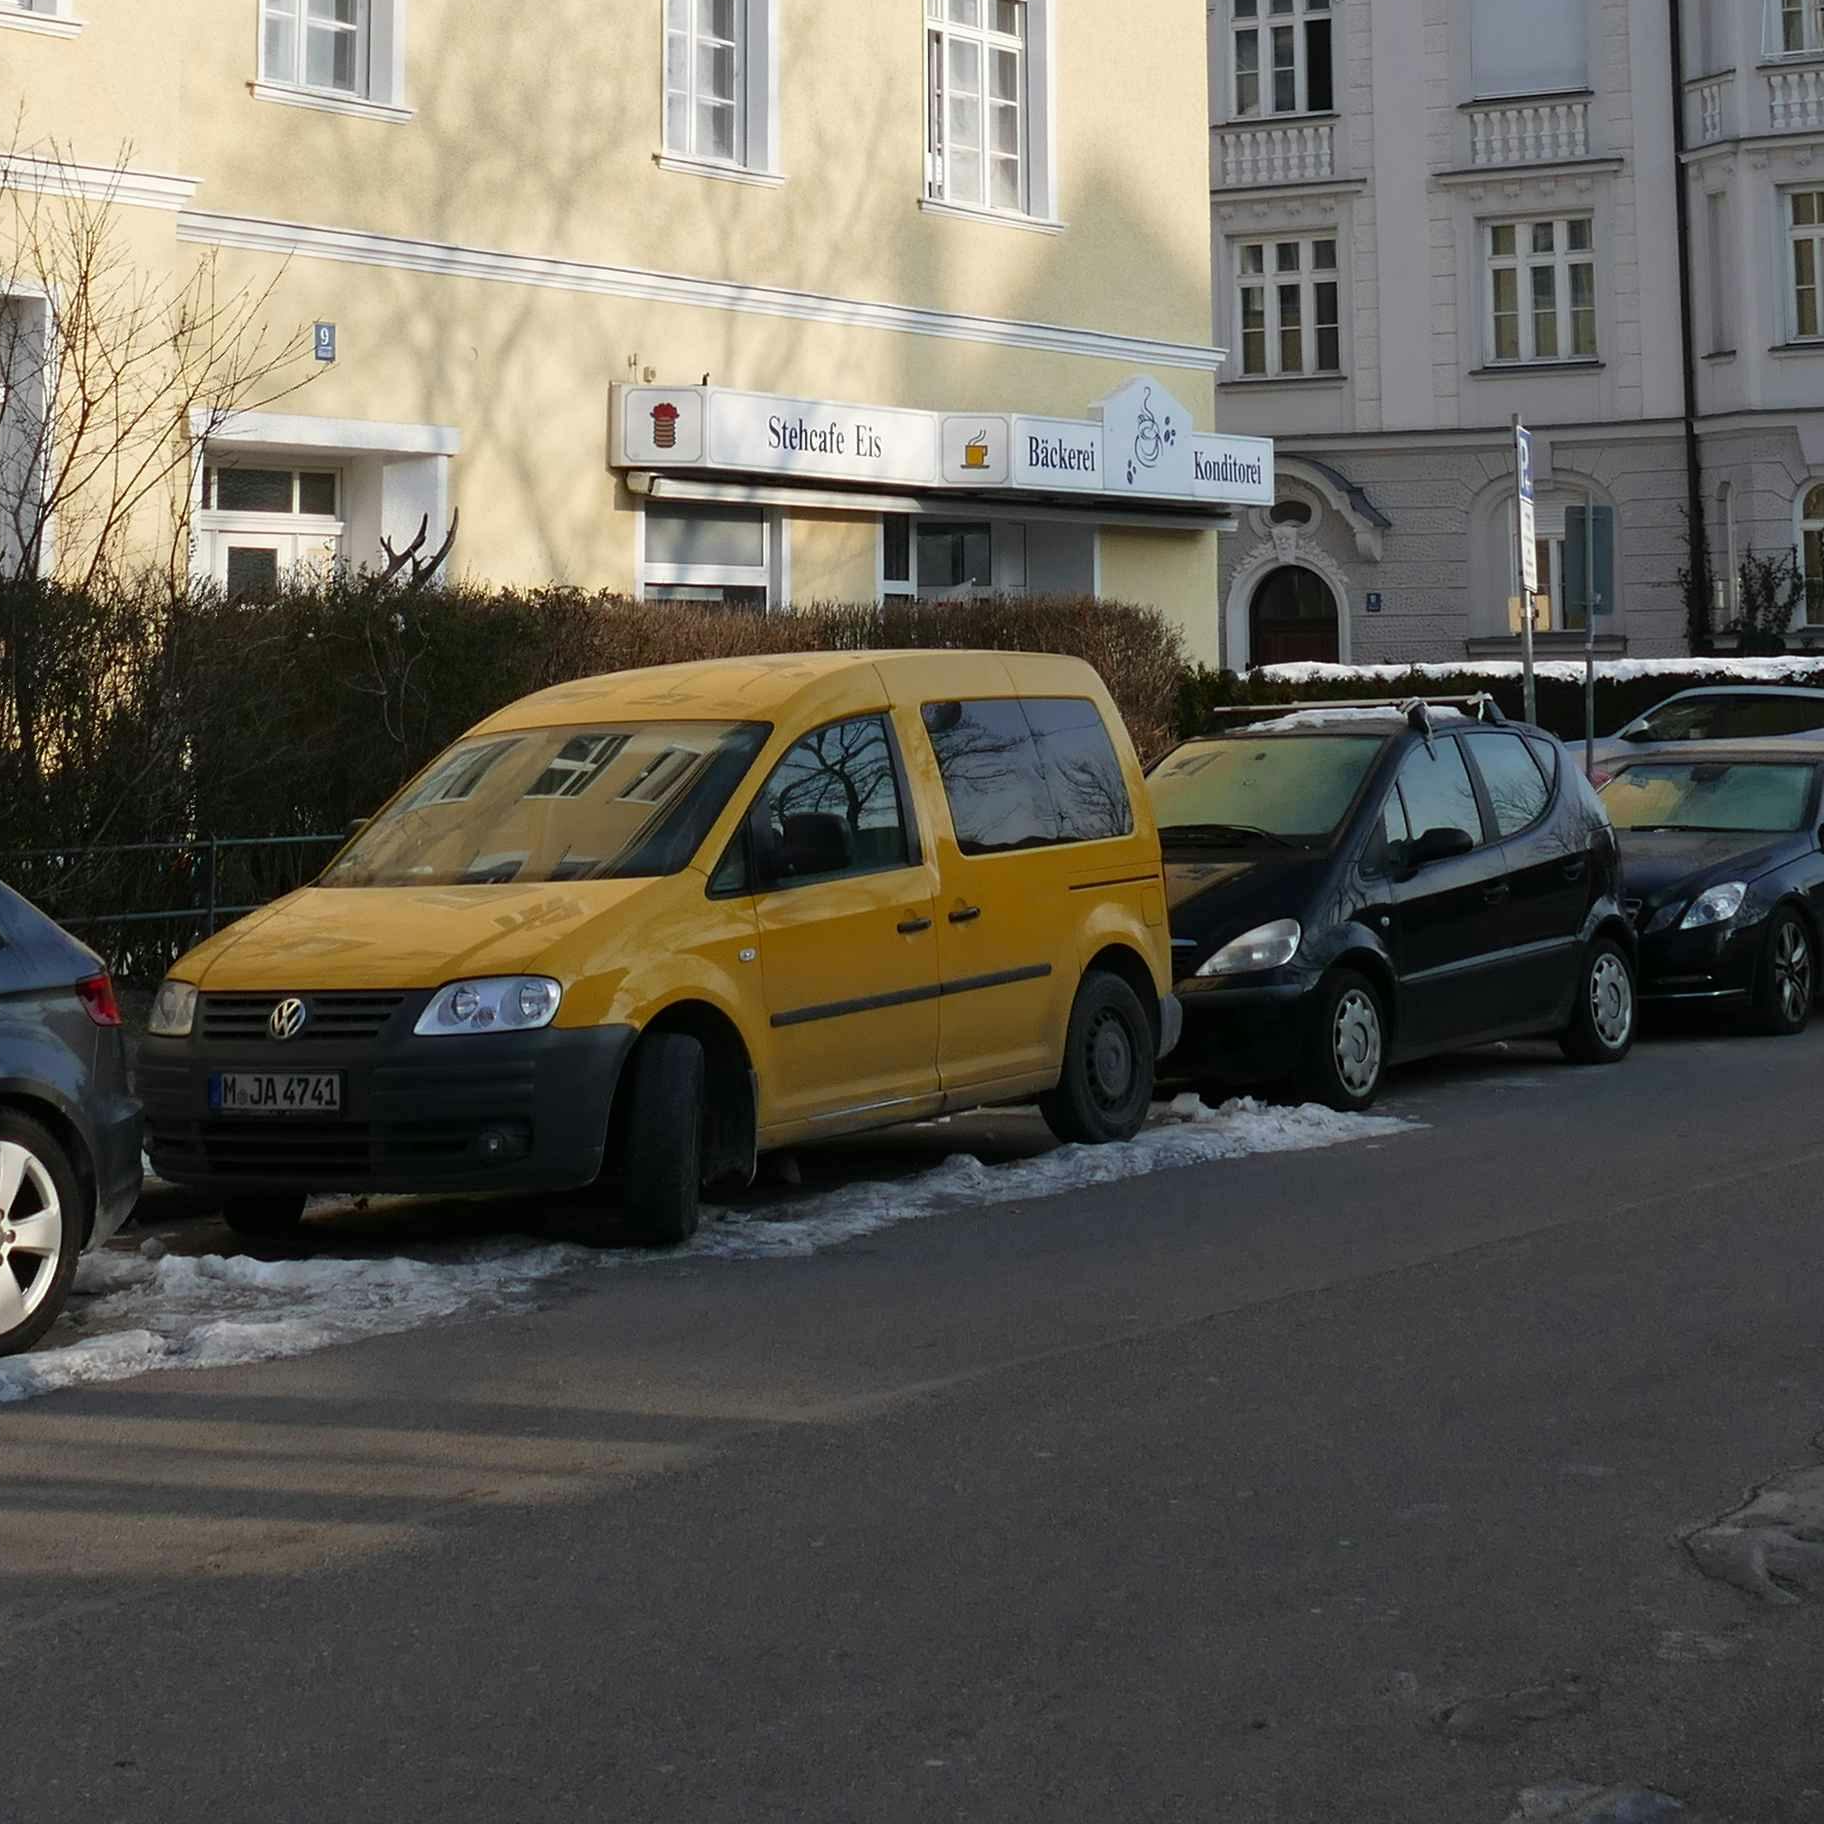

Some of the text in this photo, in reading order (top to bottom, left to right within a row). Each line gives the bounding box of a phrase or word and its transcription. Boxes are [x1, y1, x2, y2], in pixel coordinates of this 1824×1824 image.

[320, 327, 329, 346] 9
[768, 415, 882, 458] Stehcafe Eis
[1028, 436, 1095, 471] Bäckerei
[1194, 451, 1262, 484] Konditorei
[1519, 437, 1529, 489] P
[270, 998, 306, 1039] VW
[223, 1077, 337, 1106] M JA 4741
